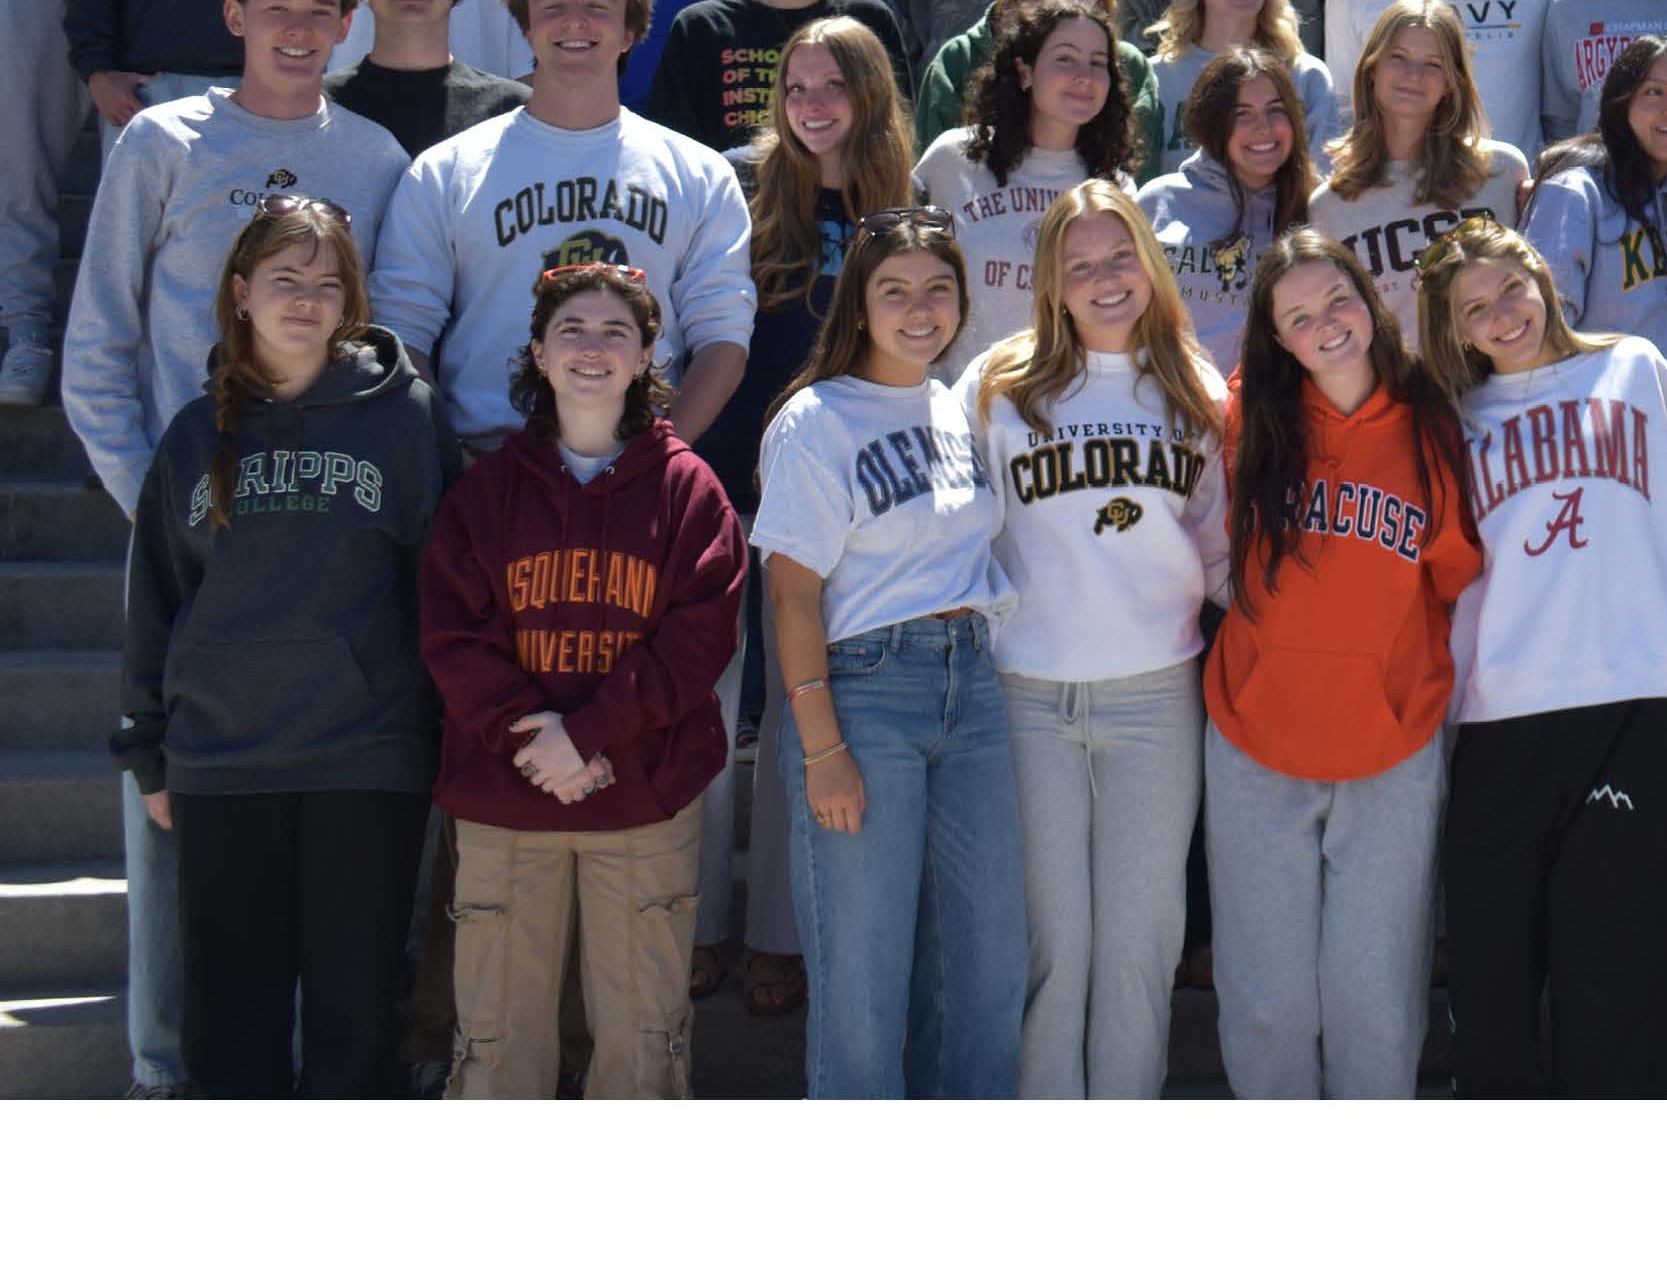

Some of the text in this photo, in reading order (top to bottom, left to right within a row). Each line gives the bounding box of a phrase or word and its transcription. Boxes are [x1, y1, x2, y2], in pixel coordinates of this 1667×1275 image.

[720, 48, 780, 65] SCHO
[721, 68, 750, 86] OF
[493, 175, 669, 247] COLORADO
[963, 190, 1009, 223] THE
[1027, 422, 1163, 448] UNIVERSITY
[1009, 437, 1206, 506] COLORADO
[189, 450, 383, 527] SRIPPS
[235, 494, 330, 514] OLLEGE
